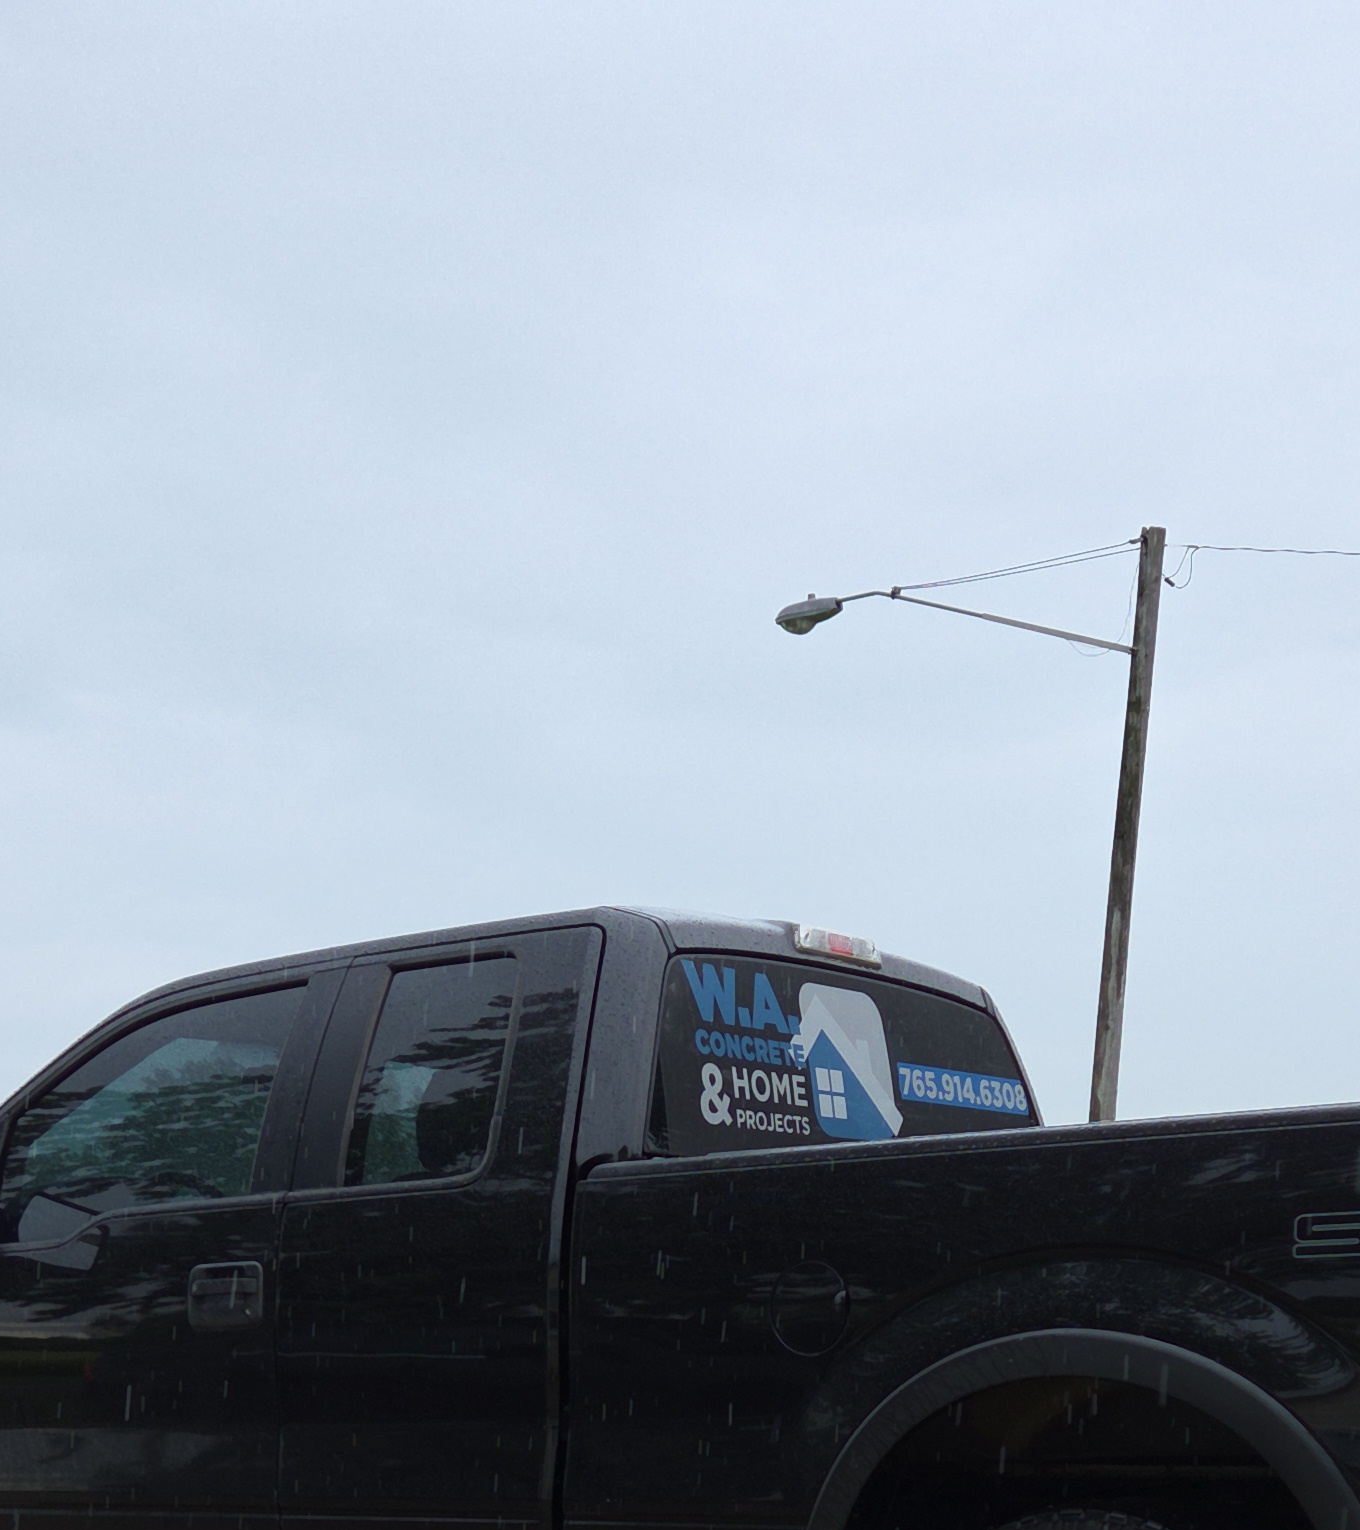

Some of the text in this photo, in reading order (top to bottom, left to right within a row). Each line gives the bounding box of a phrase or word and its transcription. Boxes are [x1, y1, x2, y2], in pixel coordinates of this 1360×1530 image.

[680, 959, 801, 1035] W.A.
[695, 1028, 807, 1069] CONCRETE
[700, 1062, 809, 1126] & HOME
[898, 1067, 1028, 1111] 765.914.6308
[735, 1108, 811, 1136] PROJECTS
